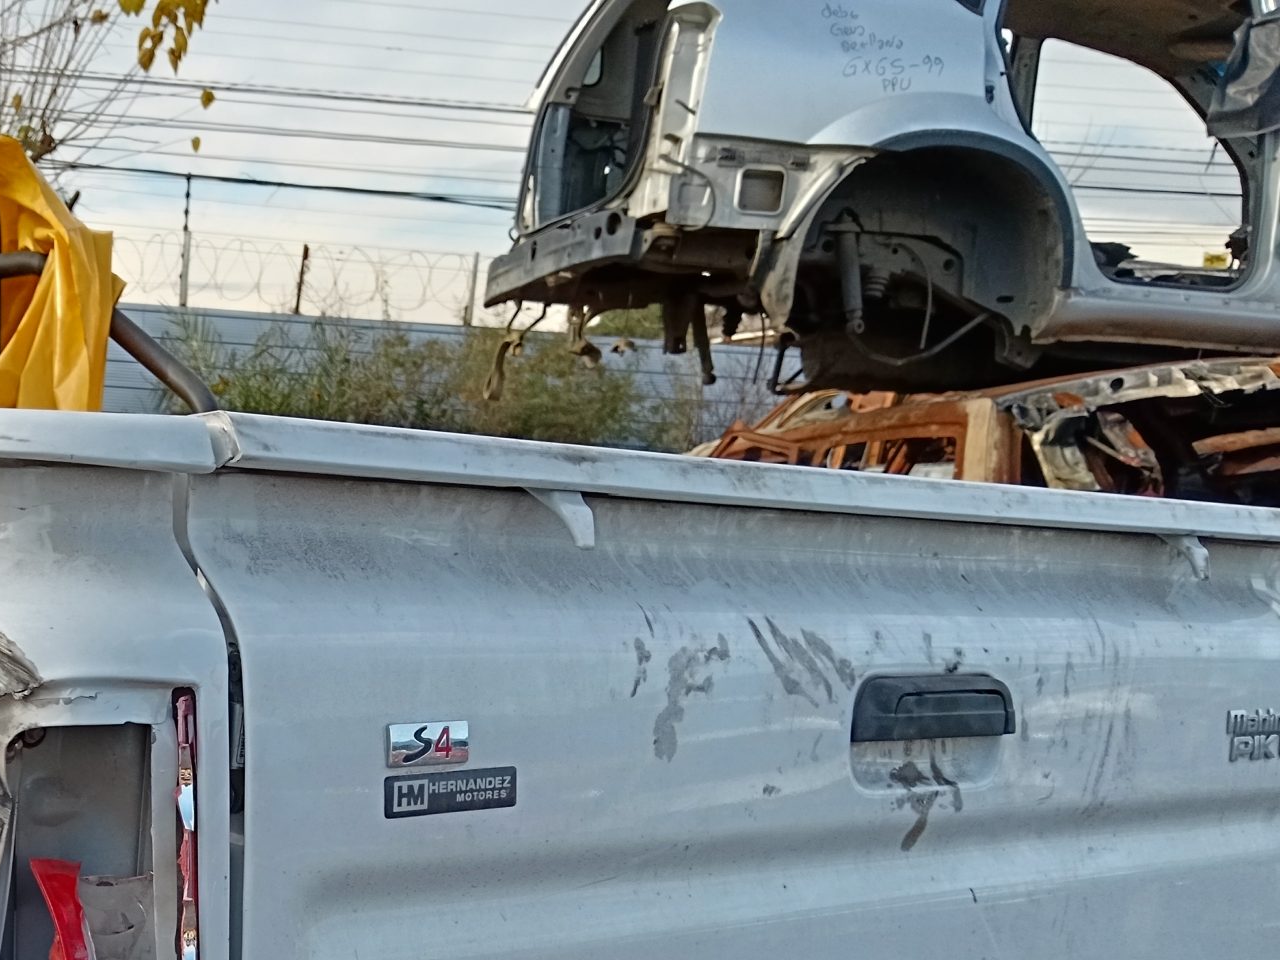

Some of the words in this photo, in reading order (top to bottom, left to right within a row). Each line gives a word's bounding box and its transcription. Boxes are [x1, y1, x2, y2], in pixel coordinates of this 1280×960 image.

[882, 76, 911, 92] PPU
[402, 725, 452, 764] S4
[394, 779, 428, 812] HM
[429, 776, 512, 794] HERNANDEZ
[456, 790, 508, 802] MOTORES
